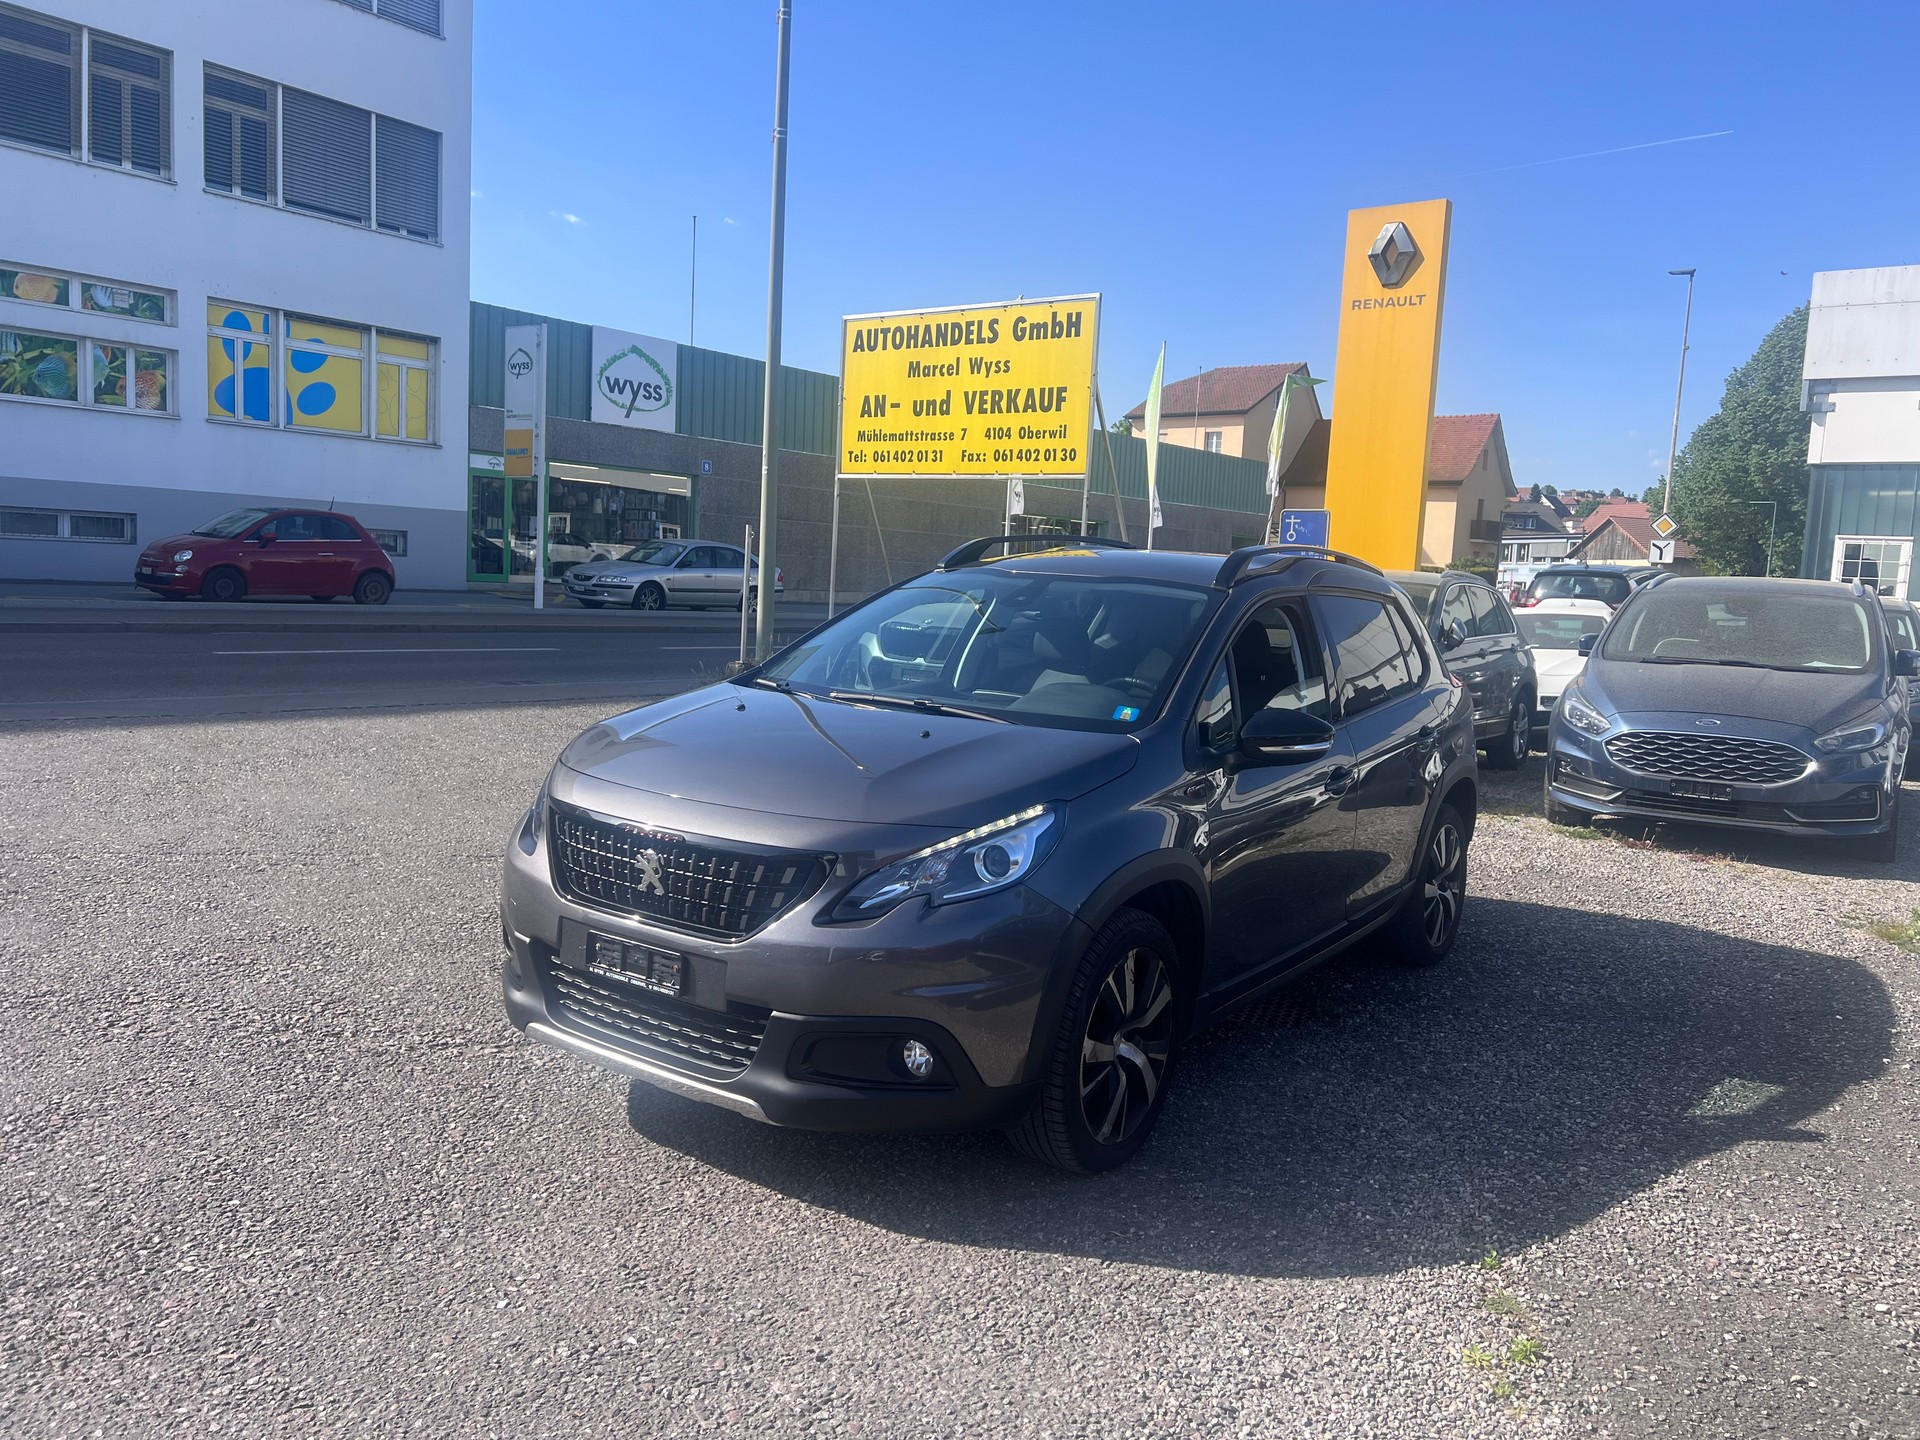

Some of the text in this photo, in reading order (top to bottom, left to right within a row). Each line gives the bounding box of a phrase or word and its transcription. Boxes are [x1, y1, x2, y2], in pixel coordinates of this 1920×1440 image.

[1352, 294, 1426, 311] RENAULT
[853, 311, 1082, 353] AUTOHANDELS GmbH
[510, 362, 530, 380] wyss
[907, 356, 1011, 378] Marcel Wyss
[605, 376, 663, 419] wyss
[860, 387, 1068, 418] AN- und VERKAUF
[857, 424, 1068, 443] Mühlemattstrasse 7 4104 Oberwil
[848, 450, 868, 463] Tel:
[961, 449, 987, 463] Fax:
[705, 463, 710, 471] 8
